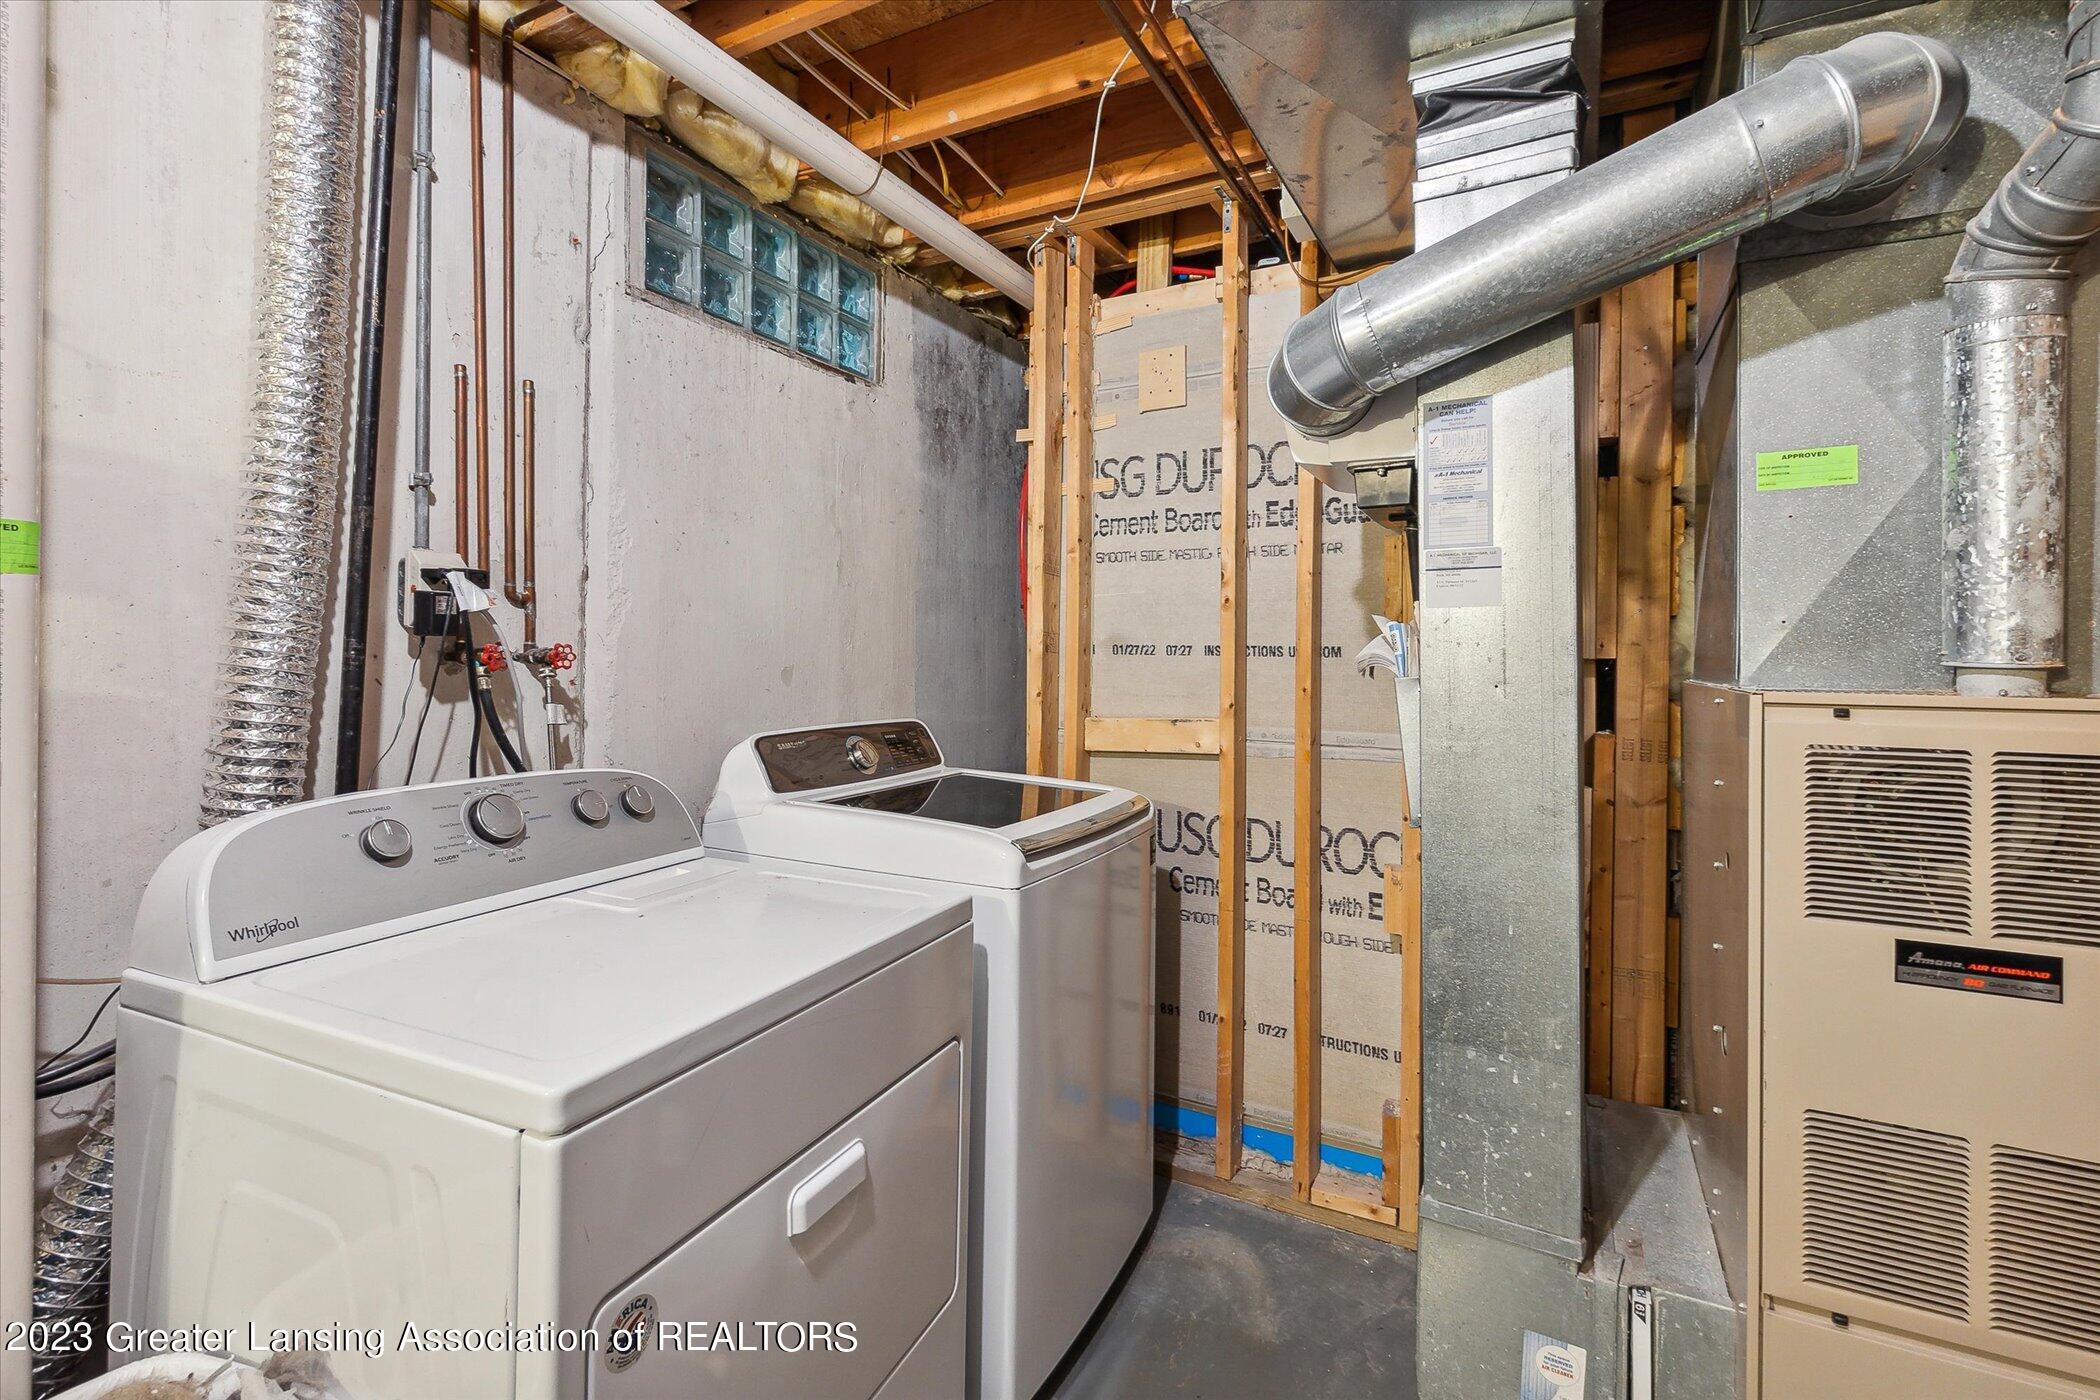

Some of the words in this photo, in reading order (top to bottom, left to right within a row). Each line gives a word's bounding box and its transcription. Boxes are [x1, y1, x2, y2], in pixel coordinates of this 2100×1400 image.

[1441, 400, 1488, 410] MECHANICAL
[1781, 451, 1829, 460] APPROVED
[1095, 551, 1137, 564] SMOOTH
[1140, 550, 1167, 562] SIDE
[1260, 544, 1290, 558] SIDE
[1112, 643, 1156, 656] 01/27/22
[434, 854, 459, 863] ACCUDRY
[1328, 896, 1363, 918] with
[227, 916, 300, 943] Whirlpool
[1362, 938, 1393, 954] SIDE
[1967, 963, 1990, 973] AIR
[1991, 966, 2051, 979] COMMAND
